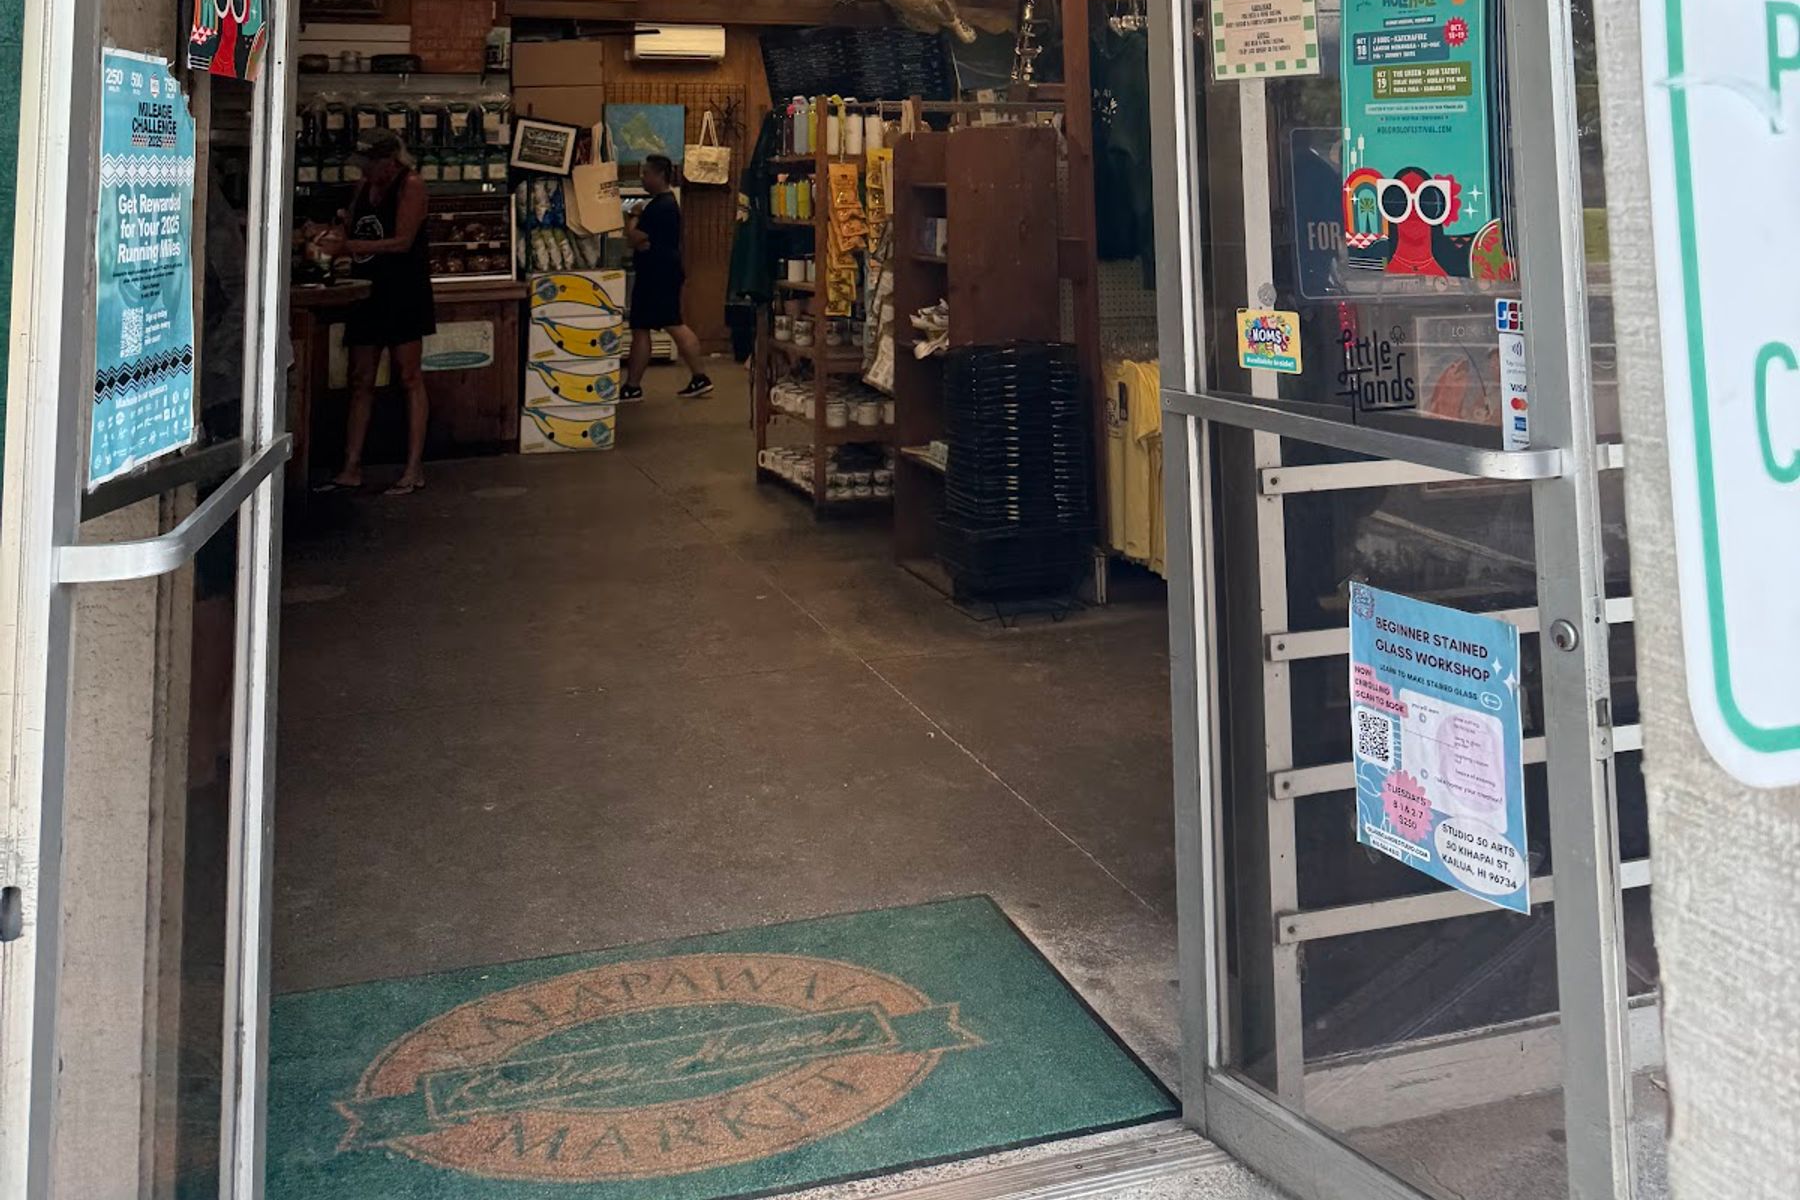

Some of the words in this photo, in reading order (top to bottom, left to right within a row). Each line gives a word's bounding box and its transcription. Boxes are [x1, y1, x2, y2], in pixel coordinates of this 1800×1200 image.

[105, 68, 124, 85] 250
[1377, 78, 1387, 89] 19
[138, 101, 173, 119] MILEAGE
[131, 117, 177, 135] CHALLENGE
[118, 193, 137, 214] Get
[139, 191, 182, 213] Rewarded
[120, 218, 136, 239] for
[138, 217, 160, 237] Your
[160, 215, 180, 235] 2025
[117, 241, 159, 264] Running
[159, 238, 181, 258] Miles
[1375, 616, 1430, 644] BEGINNER
[1433, 634, 1488, 659] STAINED
[1354, 665, 1372, 677] NOW
[1375, 638, 1413, 661] GLASS
[1416, 651, 1490, 682] WORKSHOP
[1354, 678, 1390, 696] ENROLLING
[1407, 673, 1425, 684] MAKE
[1454, 688, 1478, 700] GLASS
[1355, 690, 1374, 702] SCAN
[1374, 696, 1384, 705] TO
[1385, 700, 1405, 713] BOOK
[1441, 823, 1475, 843] STUDIO
[1490, 841, 1516, 858] ARTS
[1458, 844, 1495, 866] KIHAPAI
[1441, 853, 1475, 876] KAILUA,
[1477, 866, 1487, 879] HI
[1488, 872, 1518, 890] 96734
